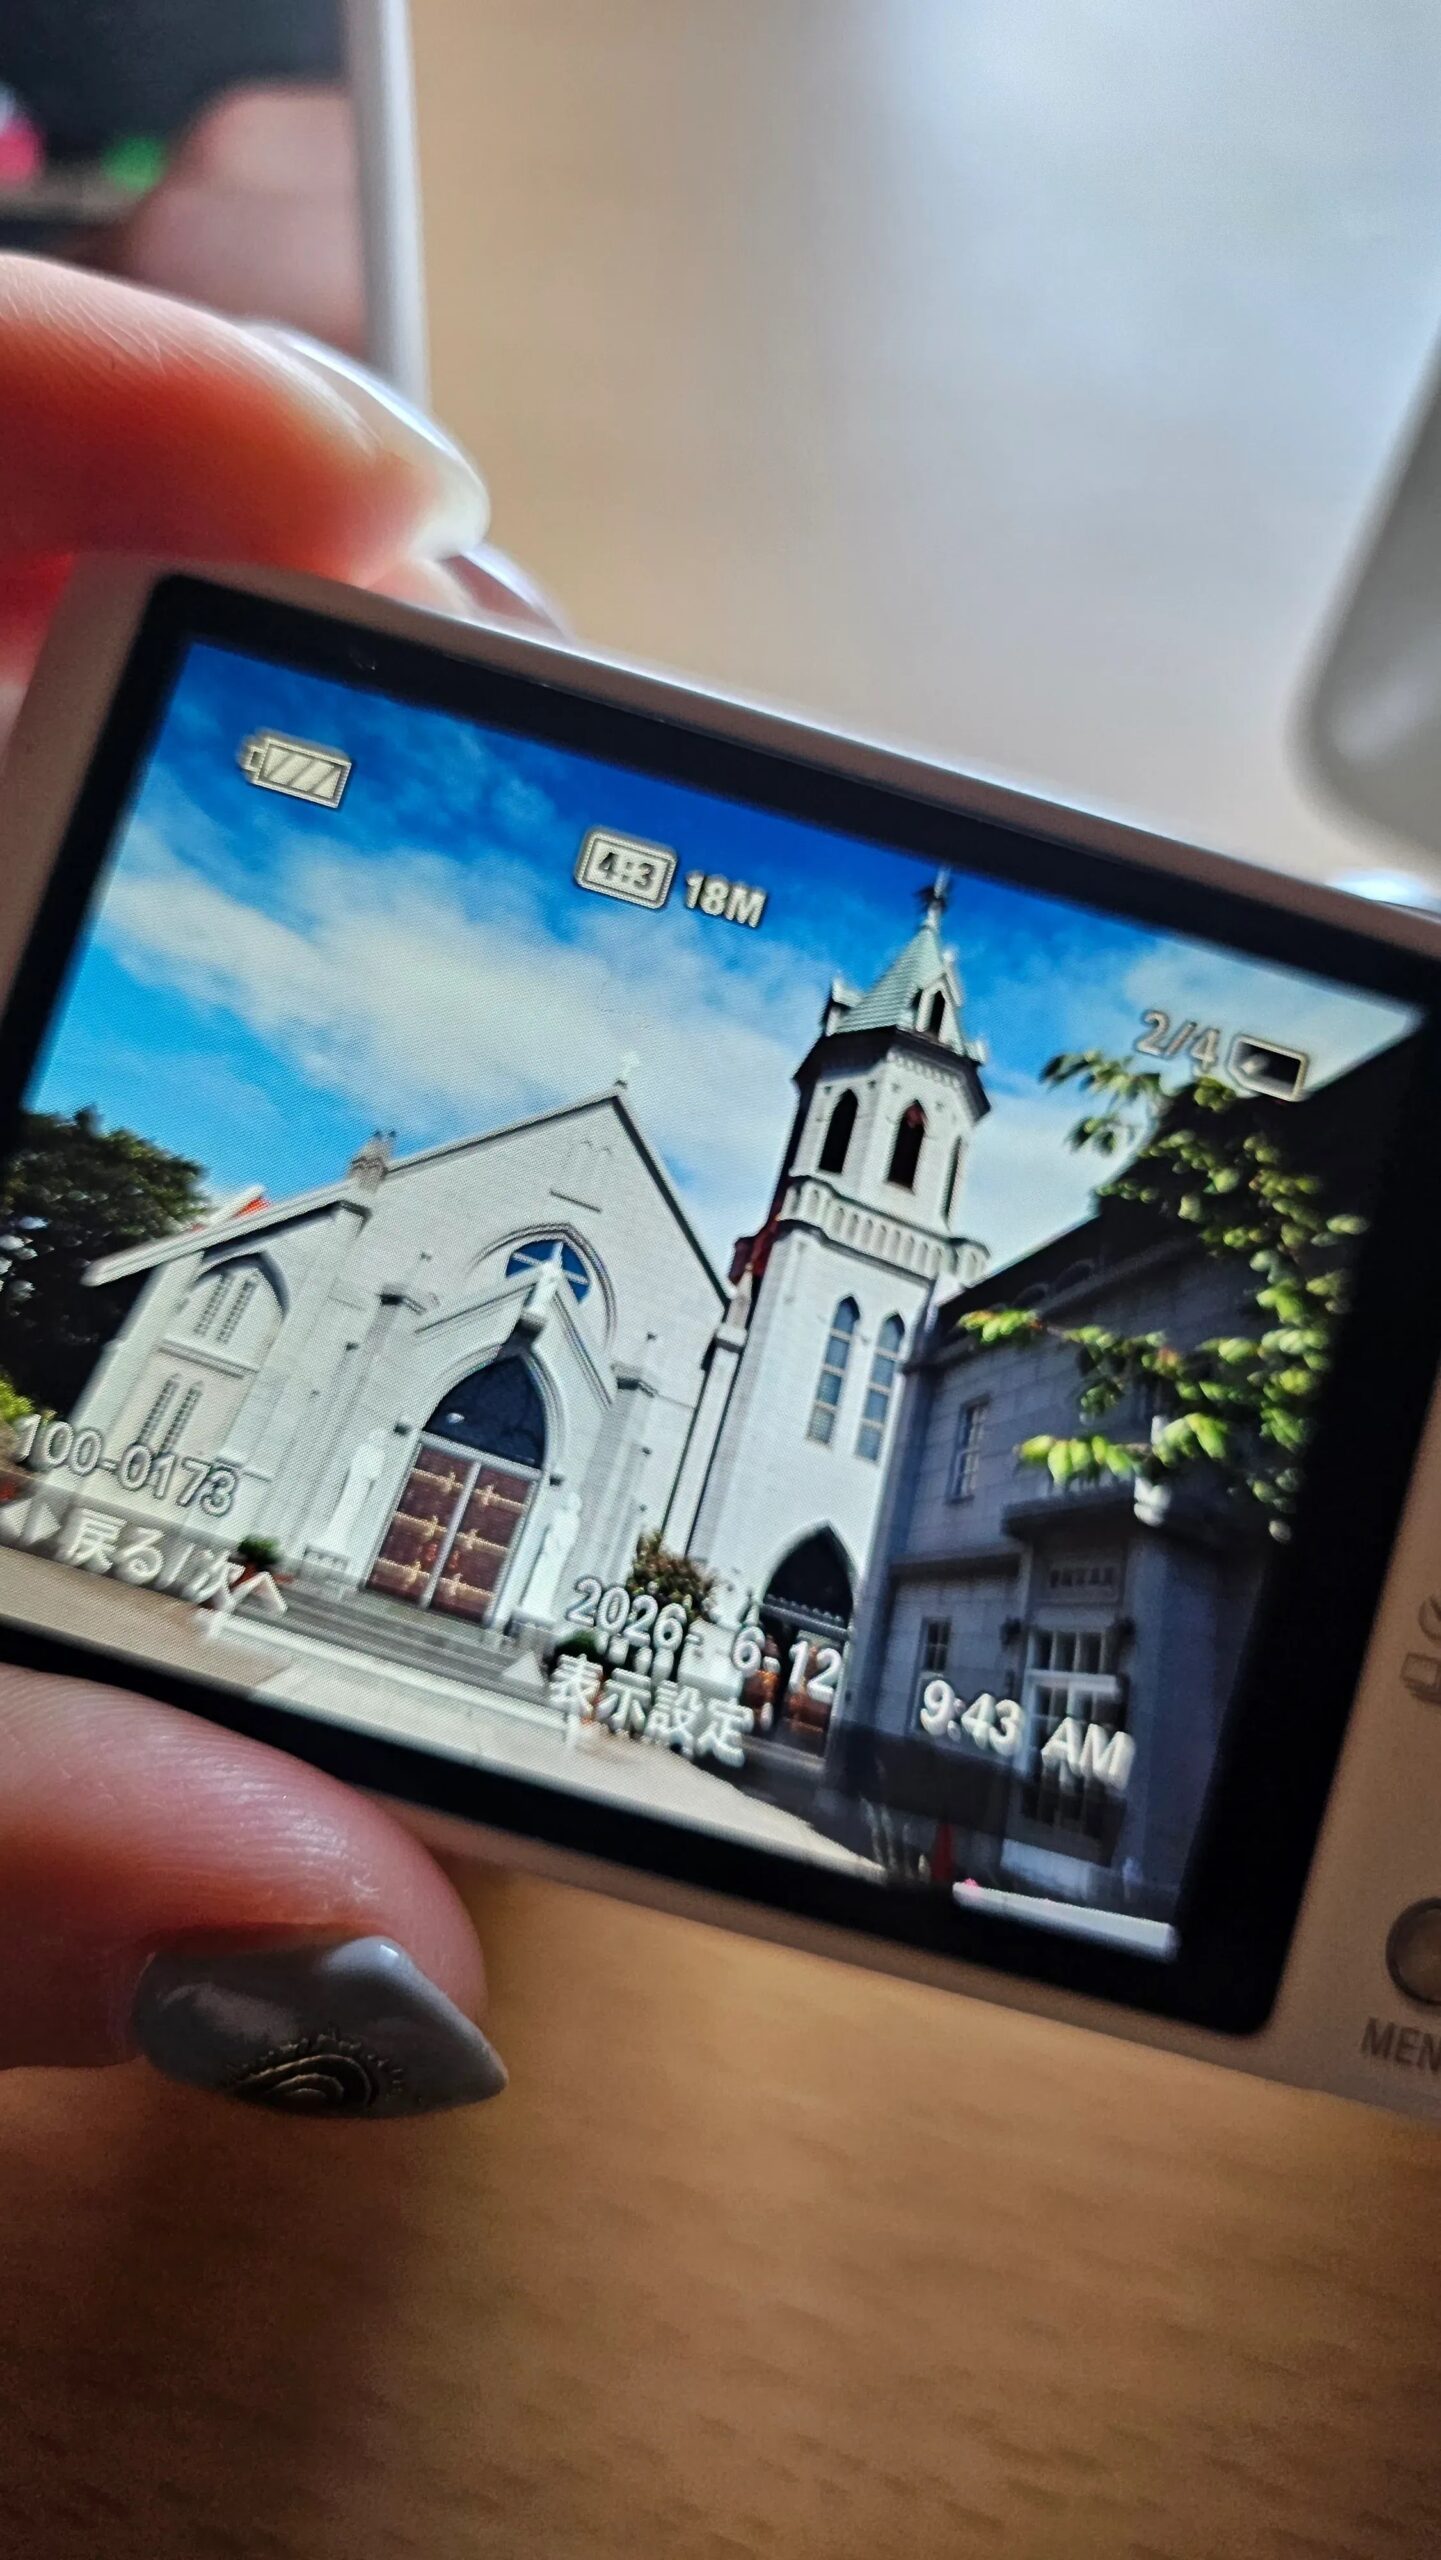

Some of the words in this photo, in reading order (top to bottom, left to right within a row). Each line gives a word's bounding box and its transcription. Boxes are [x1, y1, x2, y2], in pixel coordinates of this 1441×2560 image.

[599, 851, 655, 890] 4:3
[686, 870, 766, 928] 18M
[1135, 1009, 1221, 1072] 2/4
[14, 1413, 238, 1517] 100-0173
[66, 1507, 288, 1613] 戻る/次へ
[548, 1653, 755, 1768] 表示設定
[919, 1679, 1026, 1756] 9:43
[1040, 1716, 1136, 1791] AM
